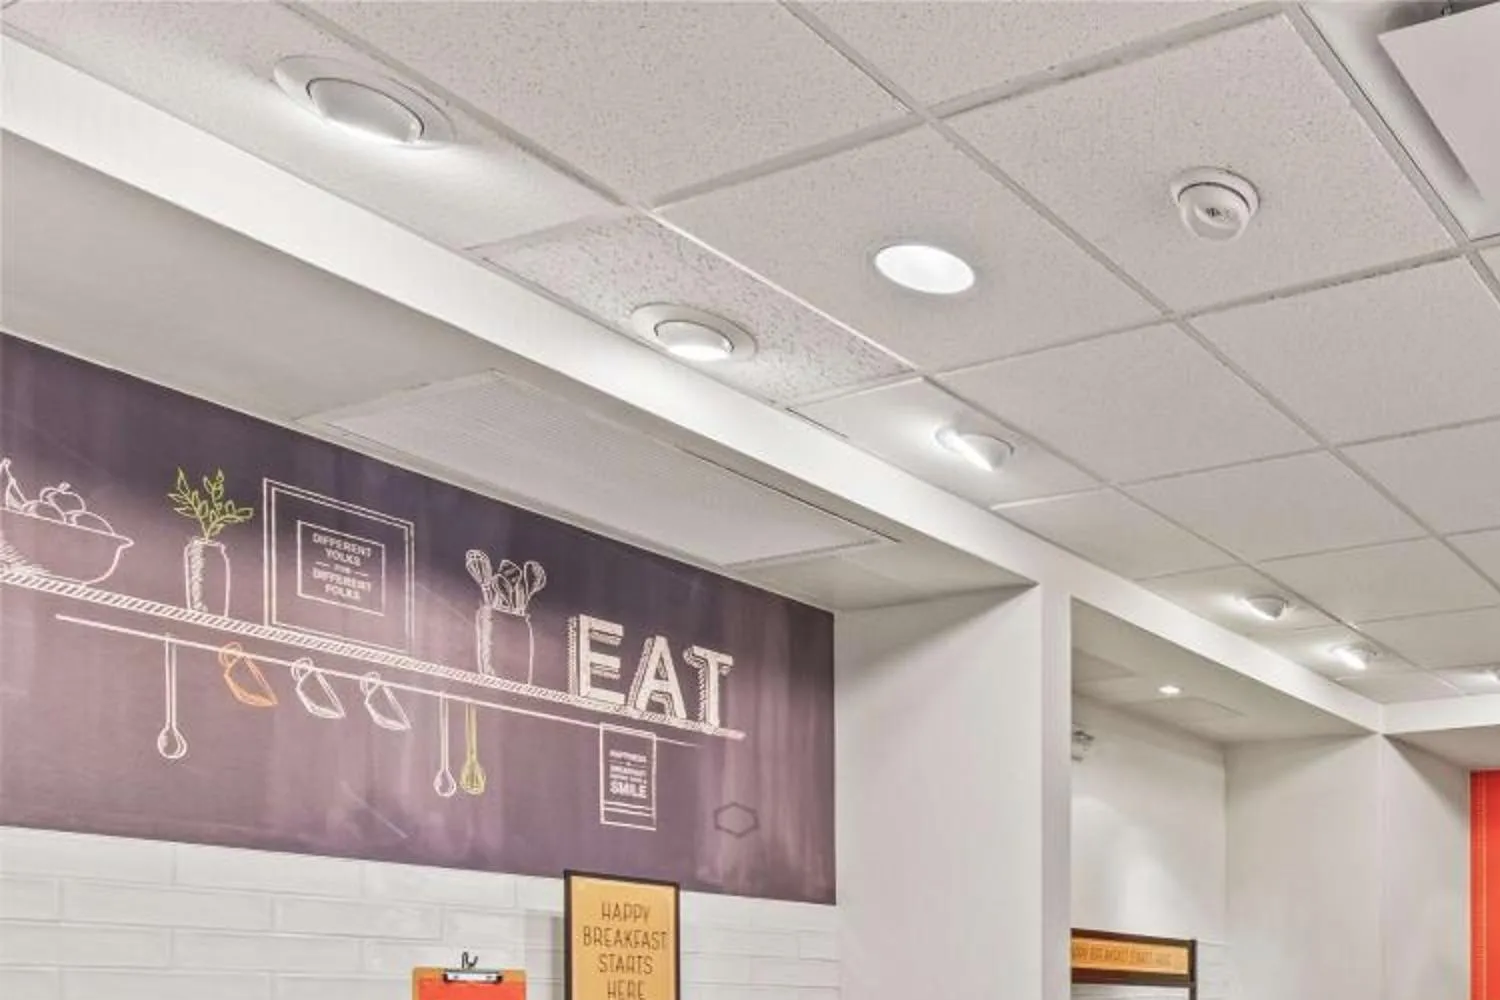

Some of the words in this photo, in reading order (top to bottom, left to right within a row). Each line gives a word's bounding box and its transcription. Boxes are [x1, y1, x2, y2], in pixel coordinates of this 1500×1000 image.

[312, 532, 371, 558] DIFFERENT
[325, 547, 361, 567] YOLKS
[312, 567, 371, 593] DIFFERENT
[568, 614, 735, 729] EAT
[609, 779, 647, 799] SMILE
[601, 901, 651, 922] HAPPY
[583, 926, 668, 950] BREAKFAST
[599, 953, 653, 975] STARTS
[607, 979, 647, 1000] HERE
